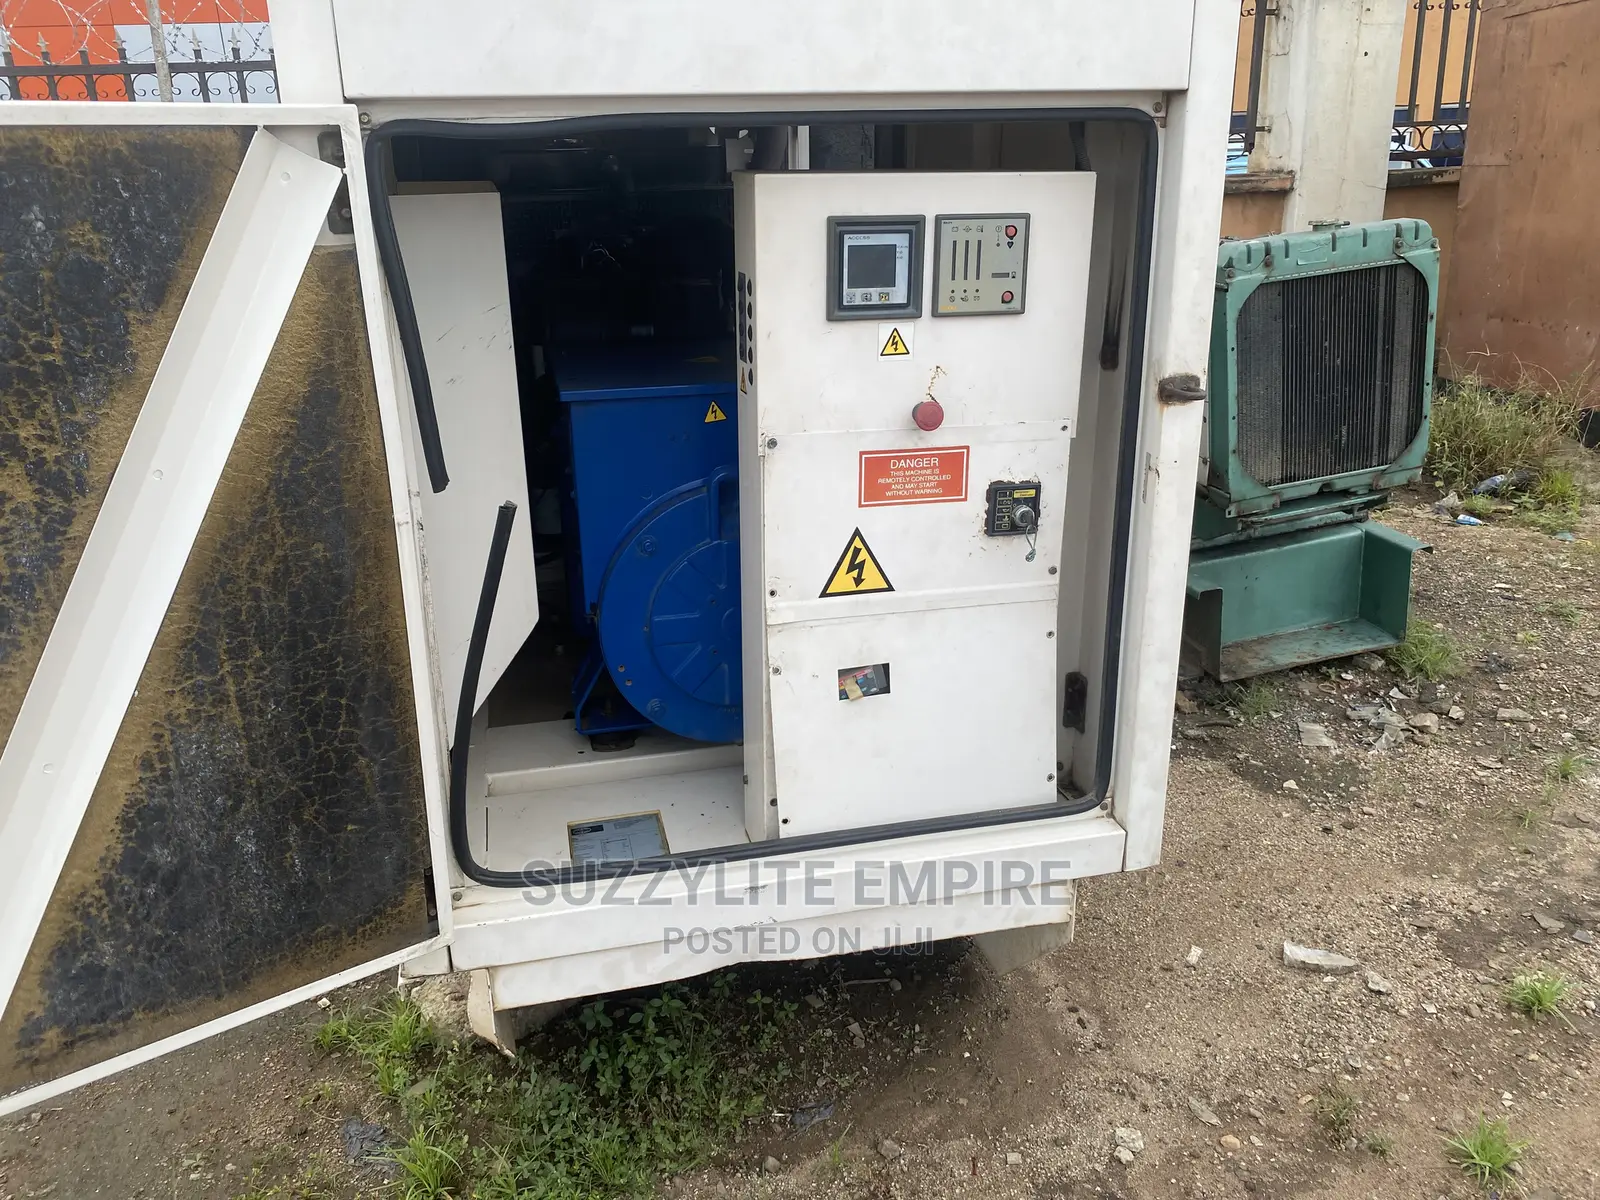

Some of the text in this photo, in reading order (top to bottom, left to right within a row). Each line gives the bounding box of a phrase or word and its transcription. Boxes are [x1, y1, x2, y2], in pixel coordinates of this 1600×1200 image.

[890, 457, 939, 469] DANGER
[877, 474, 952, 484] REMOTELY CONTROLLED
[885, 489, 913, 497] WITHOUT
